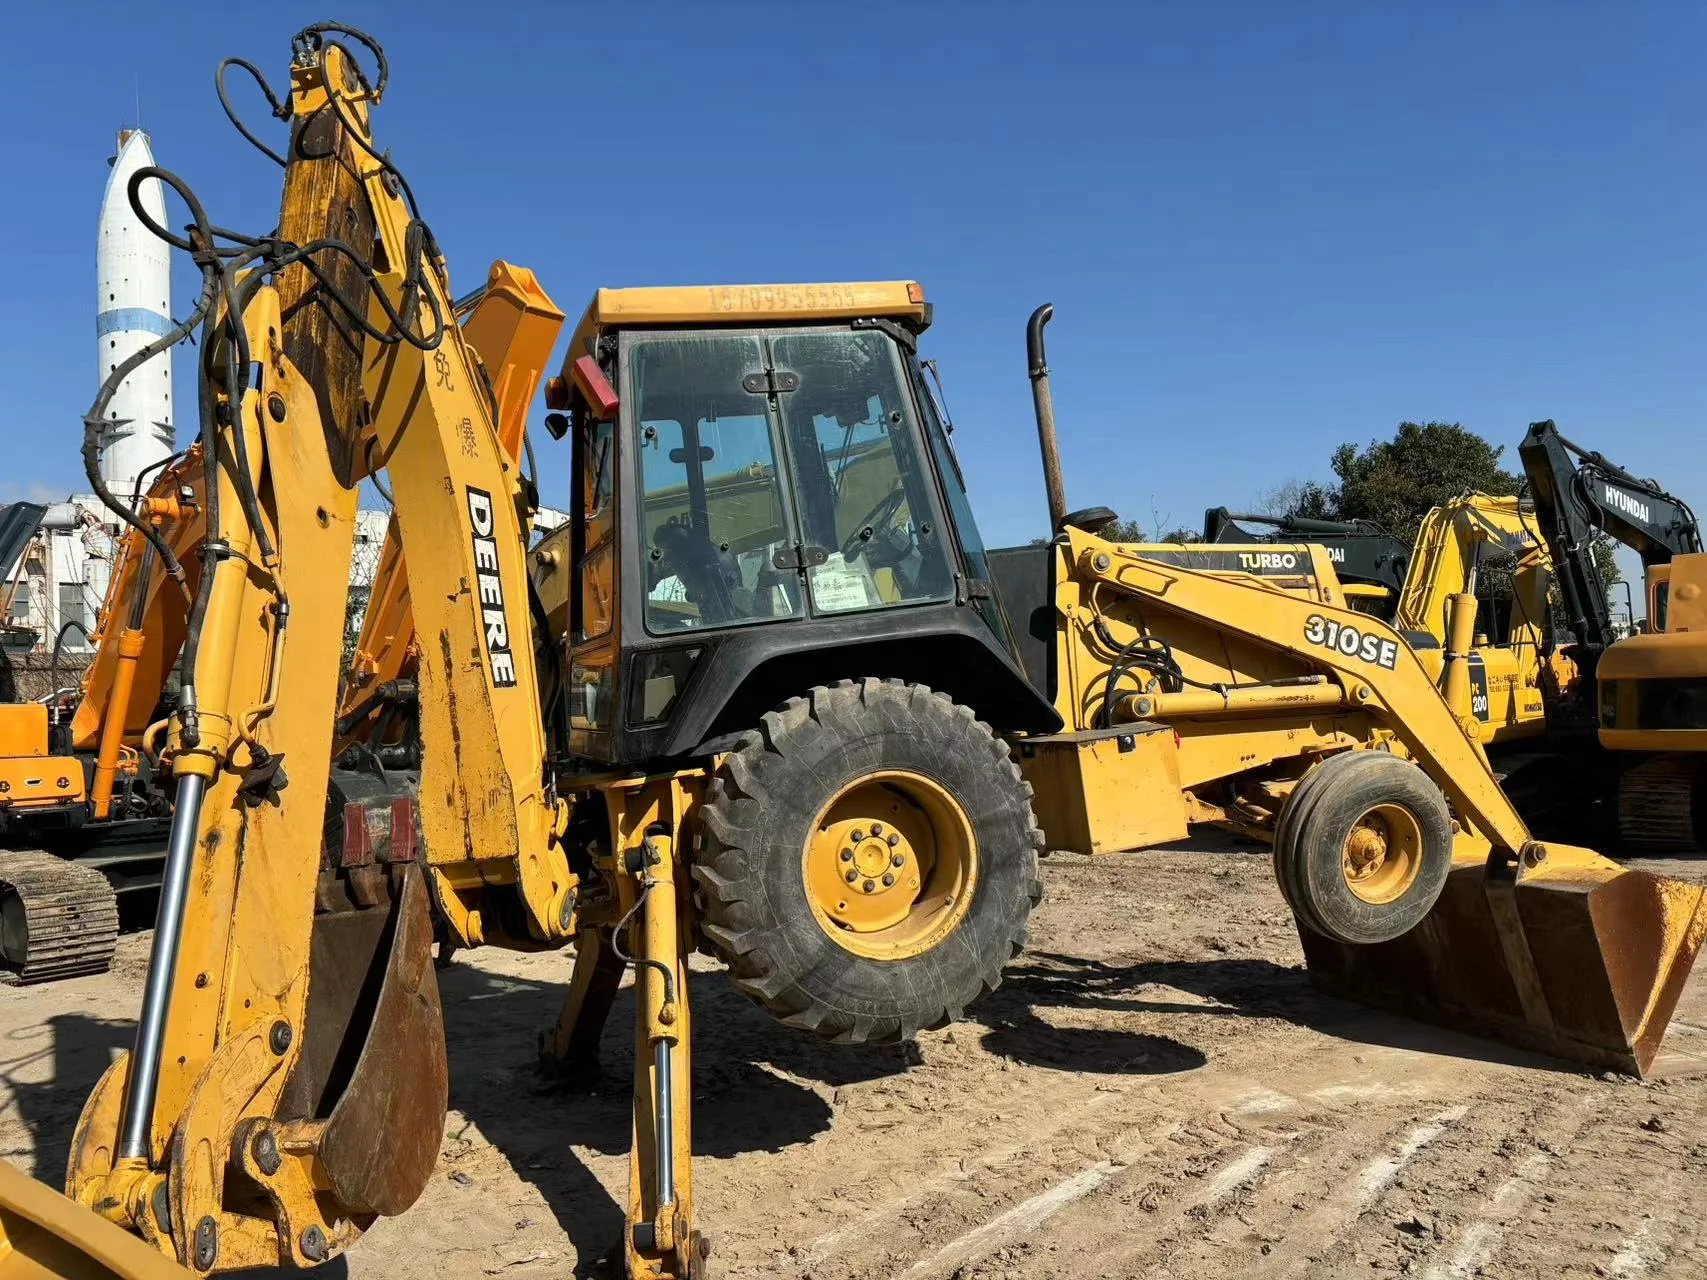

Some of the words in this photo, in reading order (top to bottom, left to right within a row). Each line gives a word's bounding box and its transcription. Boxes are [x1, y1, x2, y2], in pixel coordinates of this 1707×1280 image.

[1605, 485, 1649, 523] HYUNDAI
[1239, 553, 1296, 569] TURBO
[468, 488, 516, 687] DEERE
[1304, 614, 1398, 670] 310SE
[1473, 695, 1487, 713] 200
